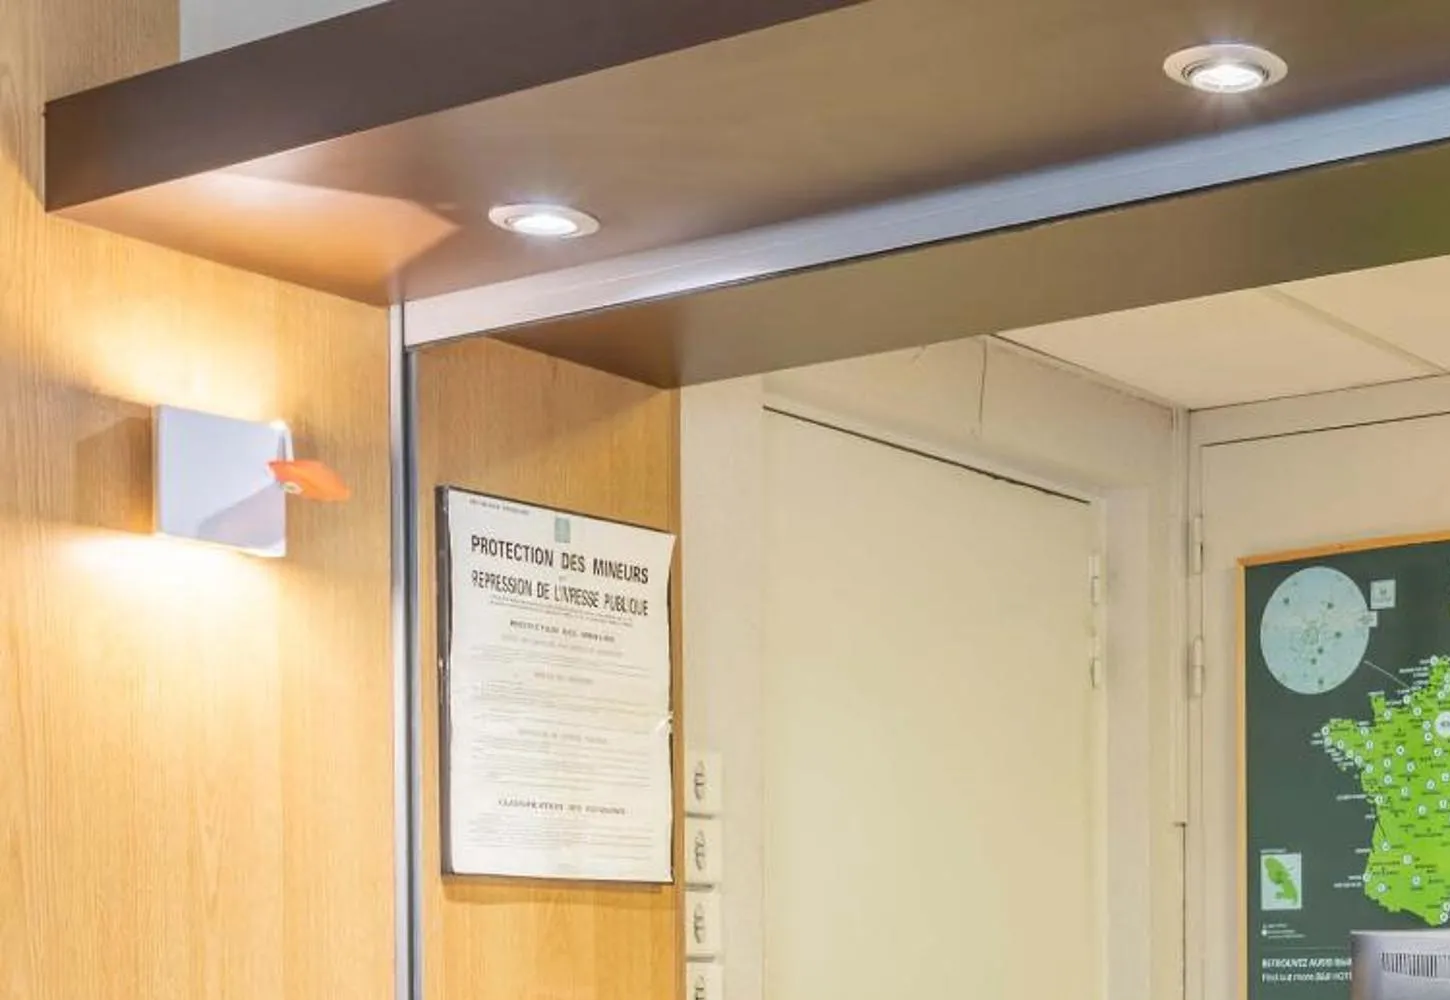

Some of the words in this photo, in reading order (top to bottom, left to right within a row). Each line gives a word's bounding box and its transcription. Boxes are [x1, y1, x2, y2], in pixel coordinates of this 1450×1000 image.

[471, 535, 554, 567] PROTECTION
[561, 552, 585, 573] DES
[593, 558, 649, 585] MINEURS
[472, 570, 532, 597] REPRESSION
[537, 581, 550, 600] DE
[603, 593, 649, 617] PUBLIQUE
